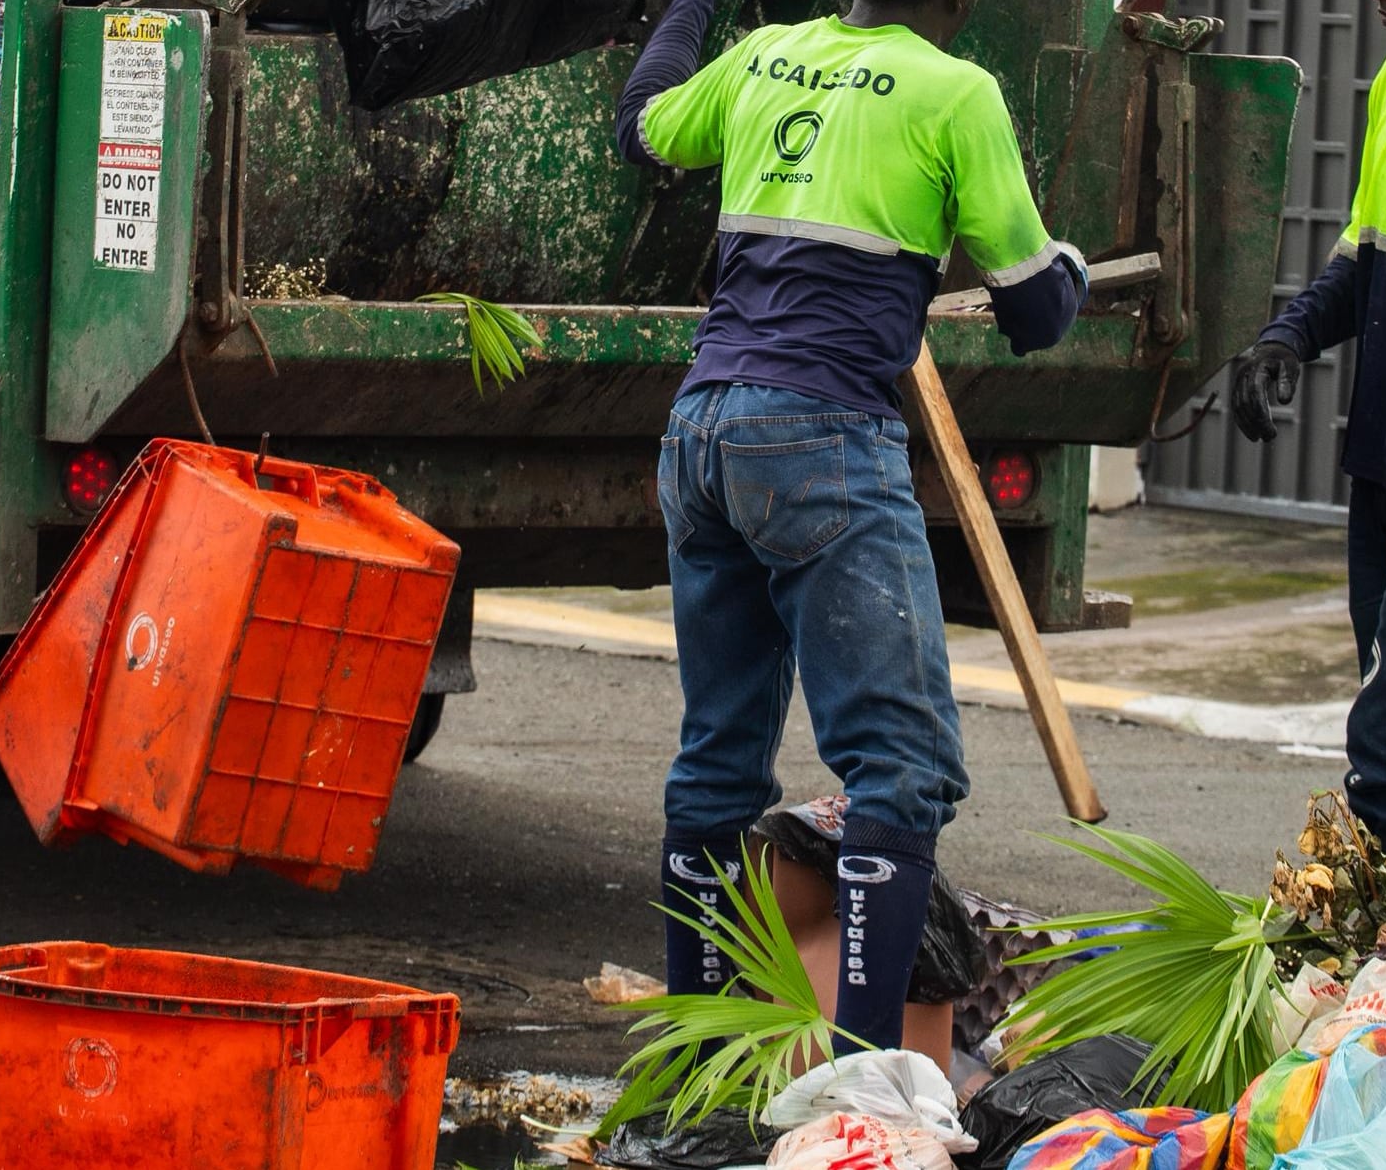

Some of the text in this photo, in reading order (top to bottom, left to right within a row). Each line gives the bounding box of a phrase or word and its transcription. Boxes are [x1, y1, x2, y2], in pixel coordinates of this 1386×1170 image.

[129, 114, 153, 123] SIENDO
[102, 173, 156, 192] DO NOT
[760, 171, 813, 184] urvaseo
[104, 199, 151, 217] ENTER
[116, 222, 136, 239] NO
[102, 247, 148, 266] ENTRE
[152, 616, 176, 687] urvaseo
[846, 888, 867, 986] urvaseo
